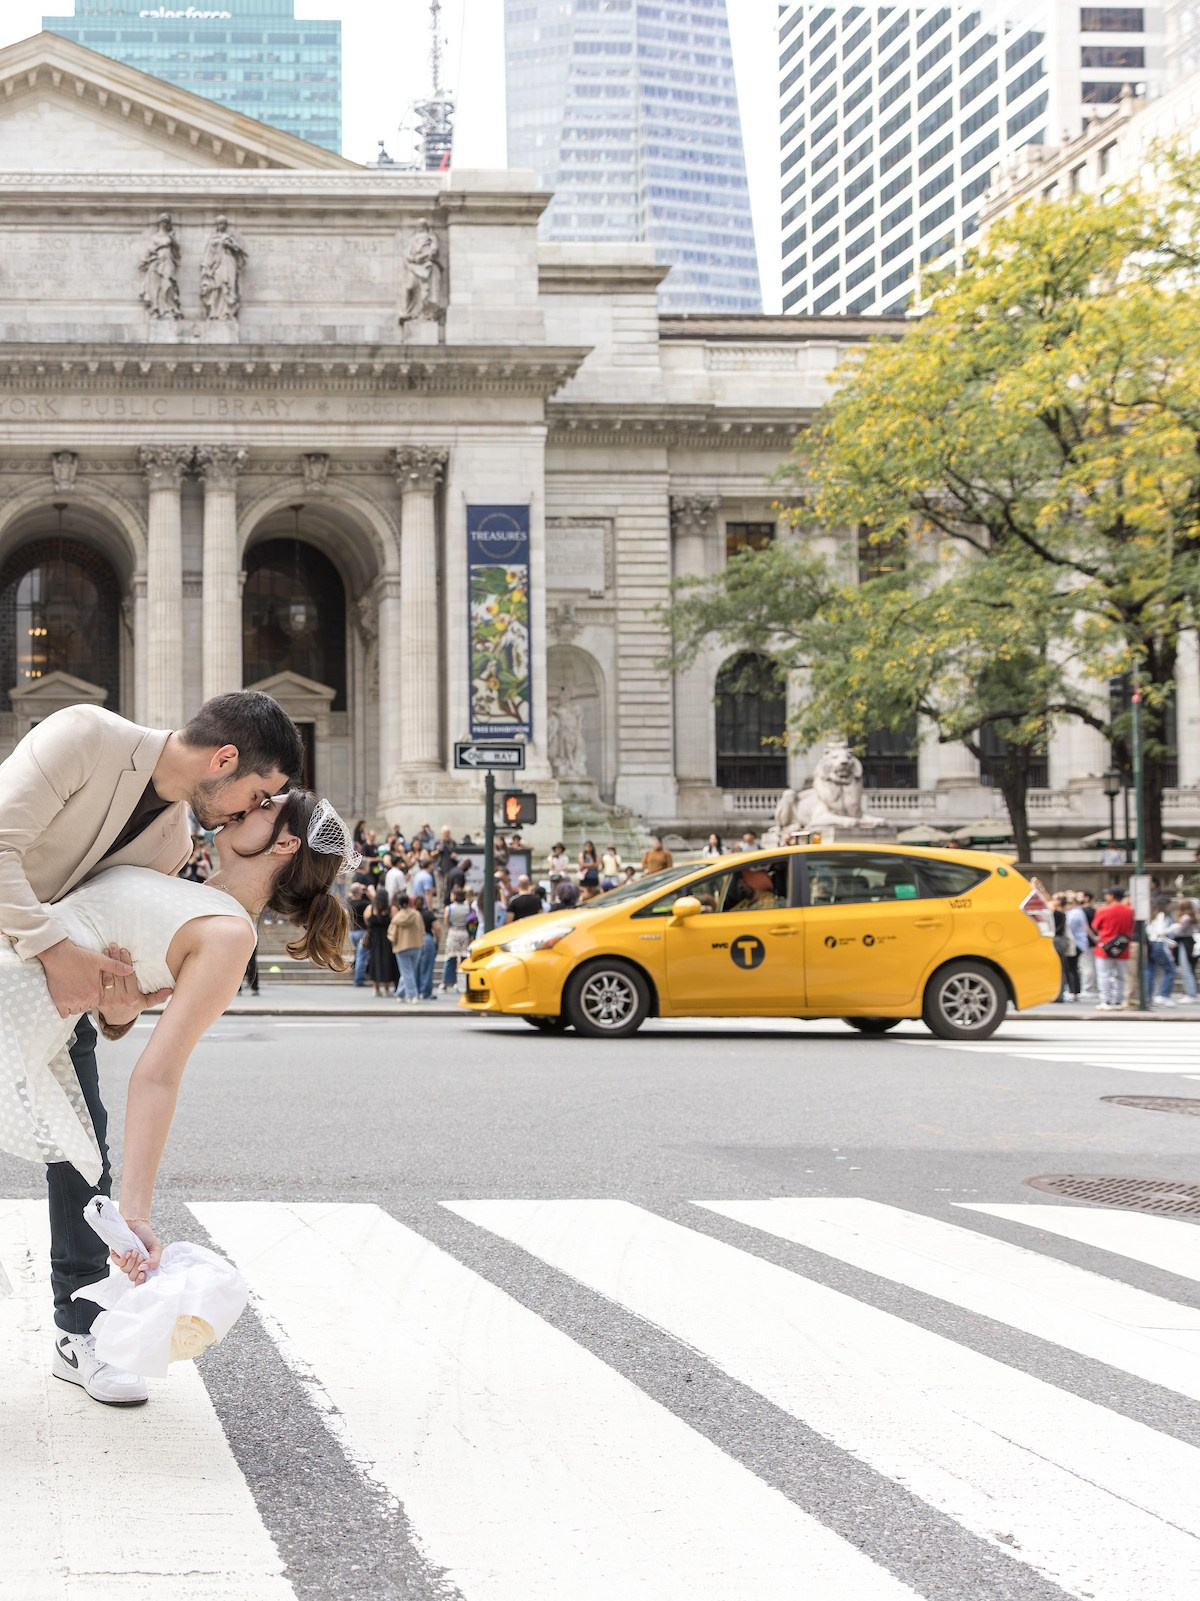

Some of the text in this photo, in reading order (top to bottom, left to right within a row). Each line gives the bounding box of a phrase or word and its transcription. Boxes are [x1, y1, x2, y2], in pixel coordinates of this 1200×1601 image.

[139, 6, 231, 18] salesforce
[249, 239, 275, 252] THE
[344, 239, 387, 253] TRUST
[80, 398, 169, 416] PUBLIC
[191, 398, 296, 417] LIBRARY
[471, 531, 527, 541] TREASURES
[468, 752, 484, 760] ONE
